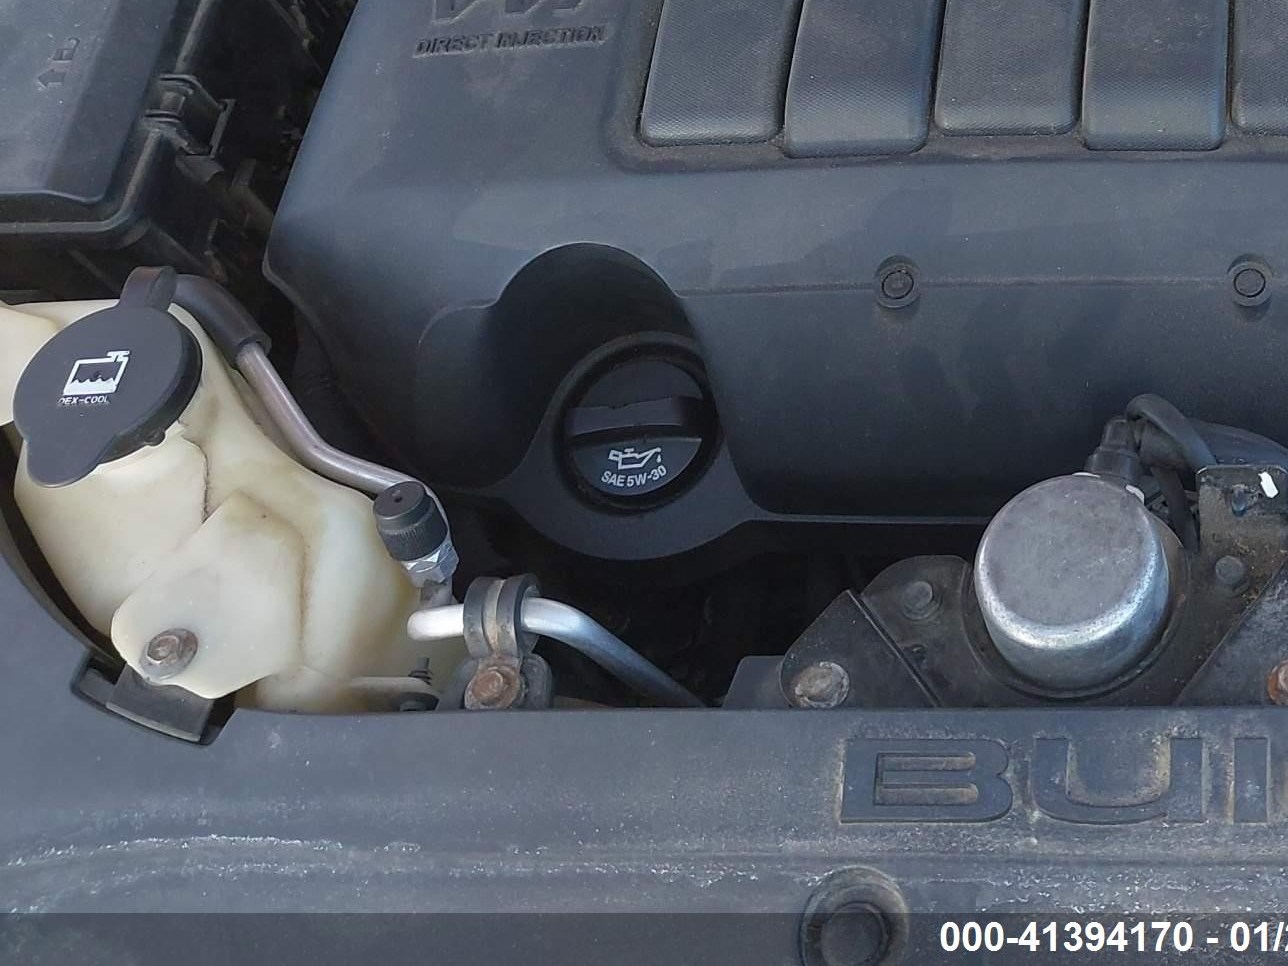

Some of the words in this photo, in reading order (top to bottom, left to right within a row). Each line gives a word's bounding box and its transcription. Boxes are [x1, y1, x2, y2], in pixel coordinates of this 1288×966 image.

[412, 34, 494, 58] DIRECT
[496, 25, 609, 50] INJECTION
[57, 395, 111, 406] DEX-COOL
[601, 470, 626, 487] SAE
[626, 465, 667, 487] 5W-30
